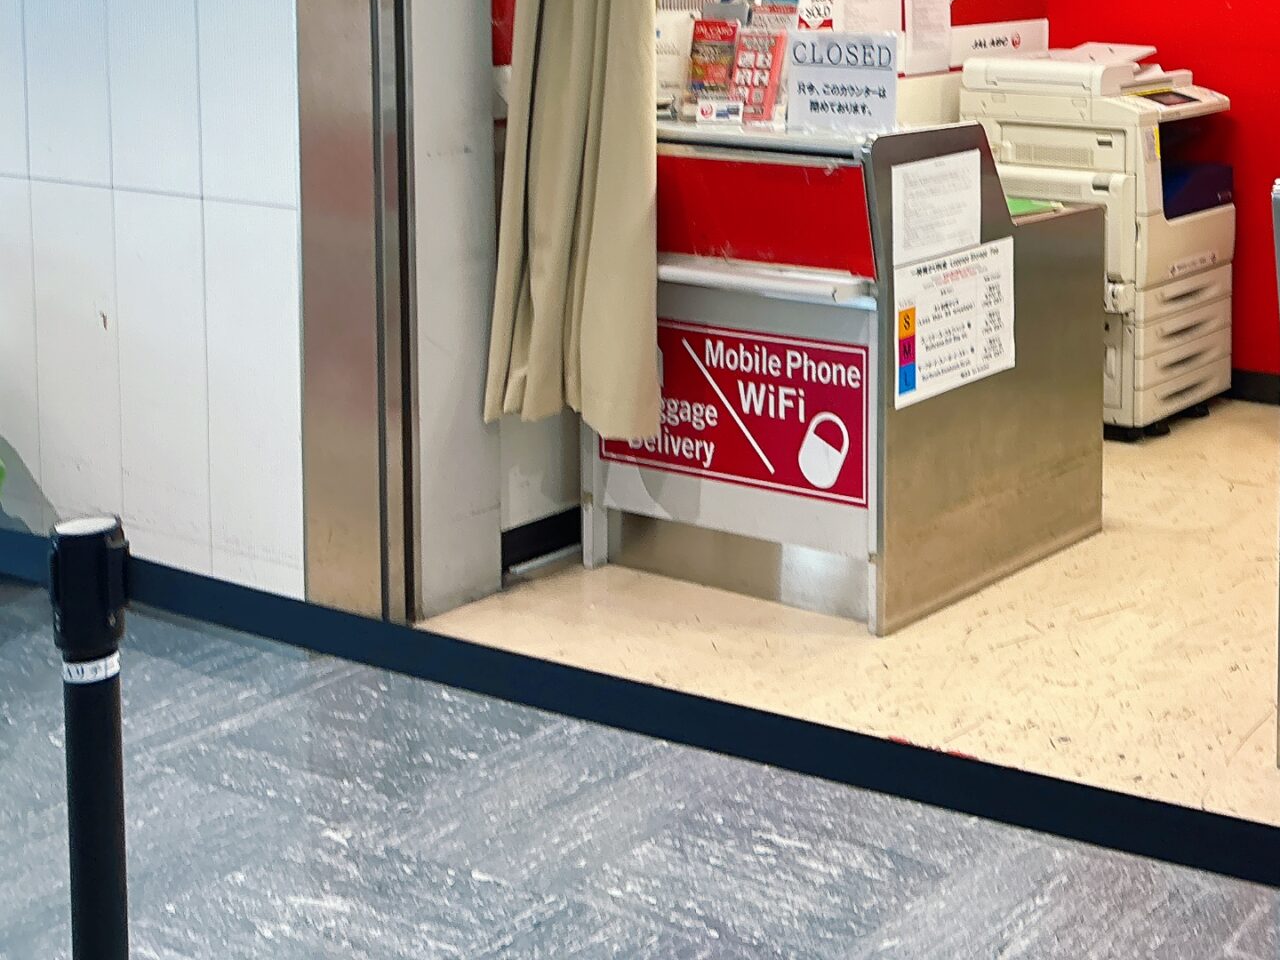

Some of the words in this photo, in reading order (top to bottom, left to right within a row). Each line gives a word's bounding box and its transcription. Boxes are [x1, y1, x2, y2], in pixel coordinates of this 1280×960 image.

[793, 41, 892, 68] CLOSED
[903, 314, 911, 331] S
[705, 338, 783, 378] Mobile
[786, 350, 861, 390] Phone
[660, 397, 719, 431] gage
[737, 380, 806, 424] WiFi
